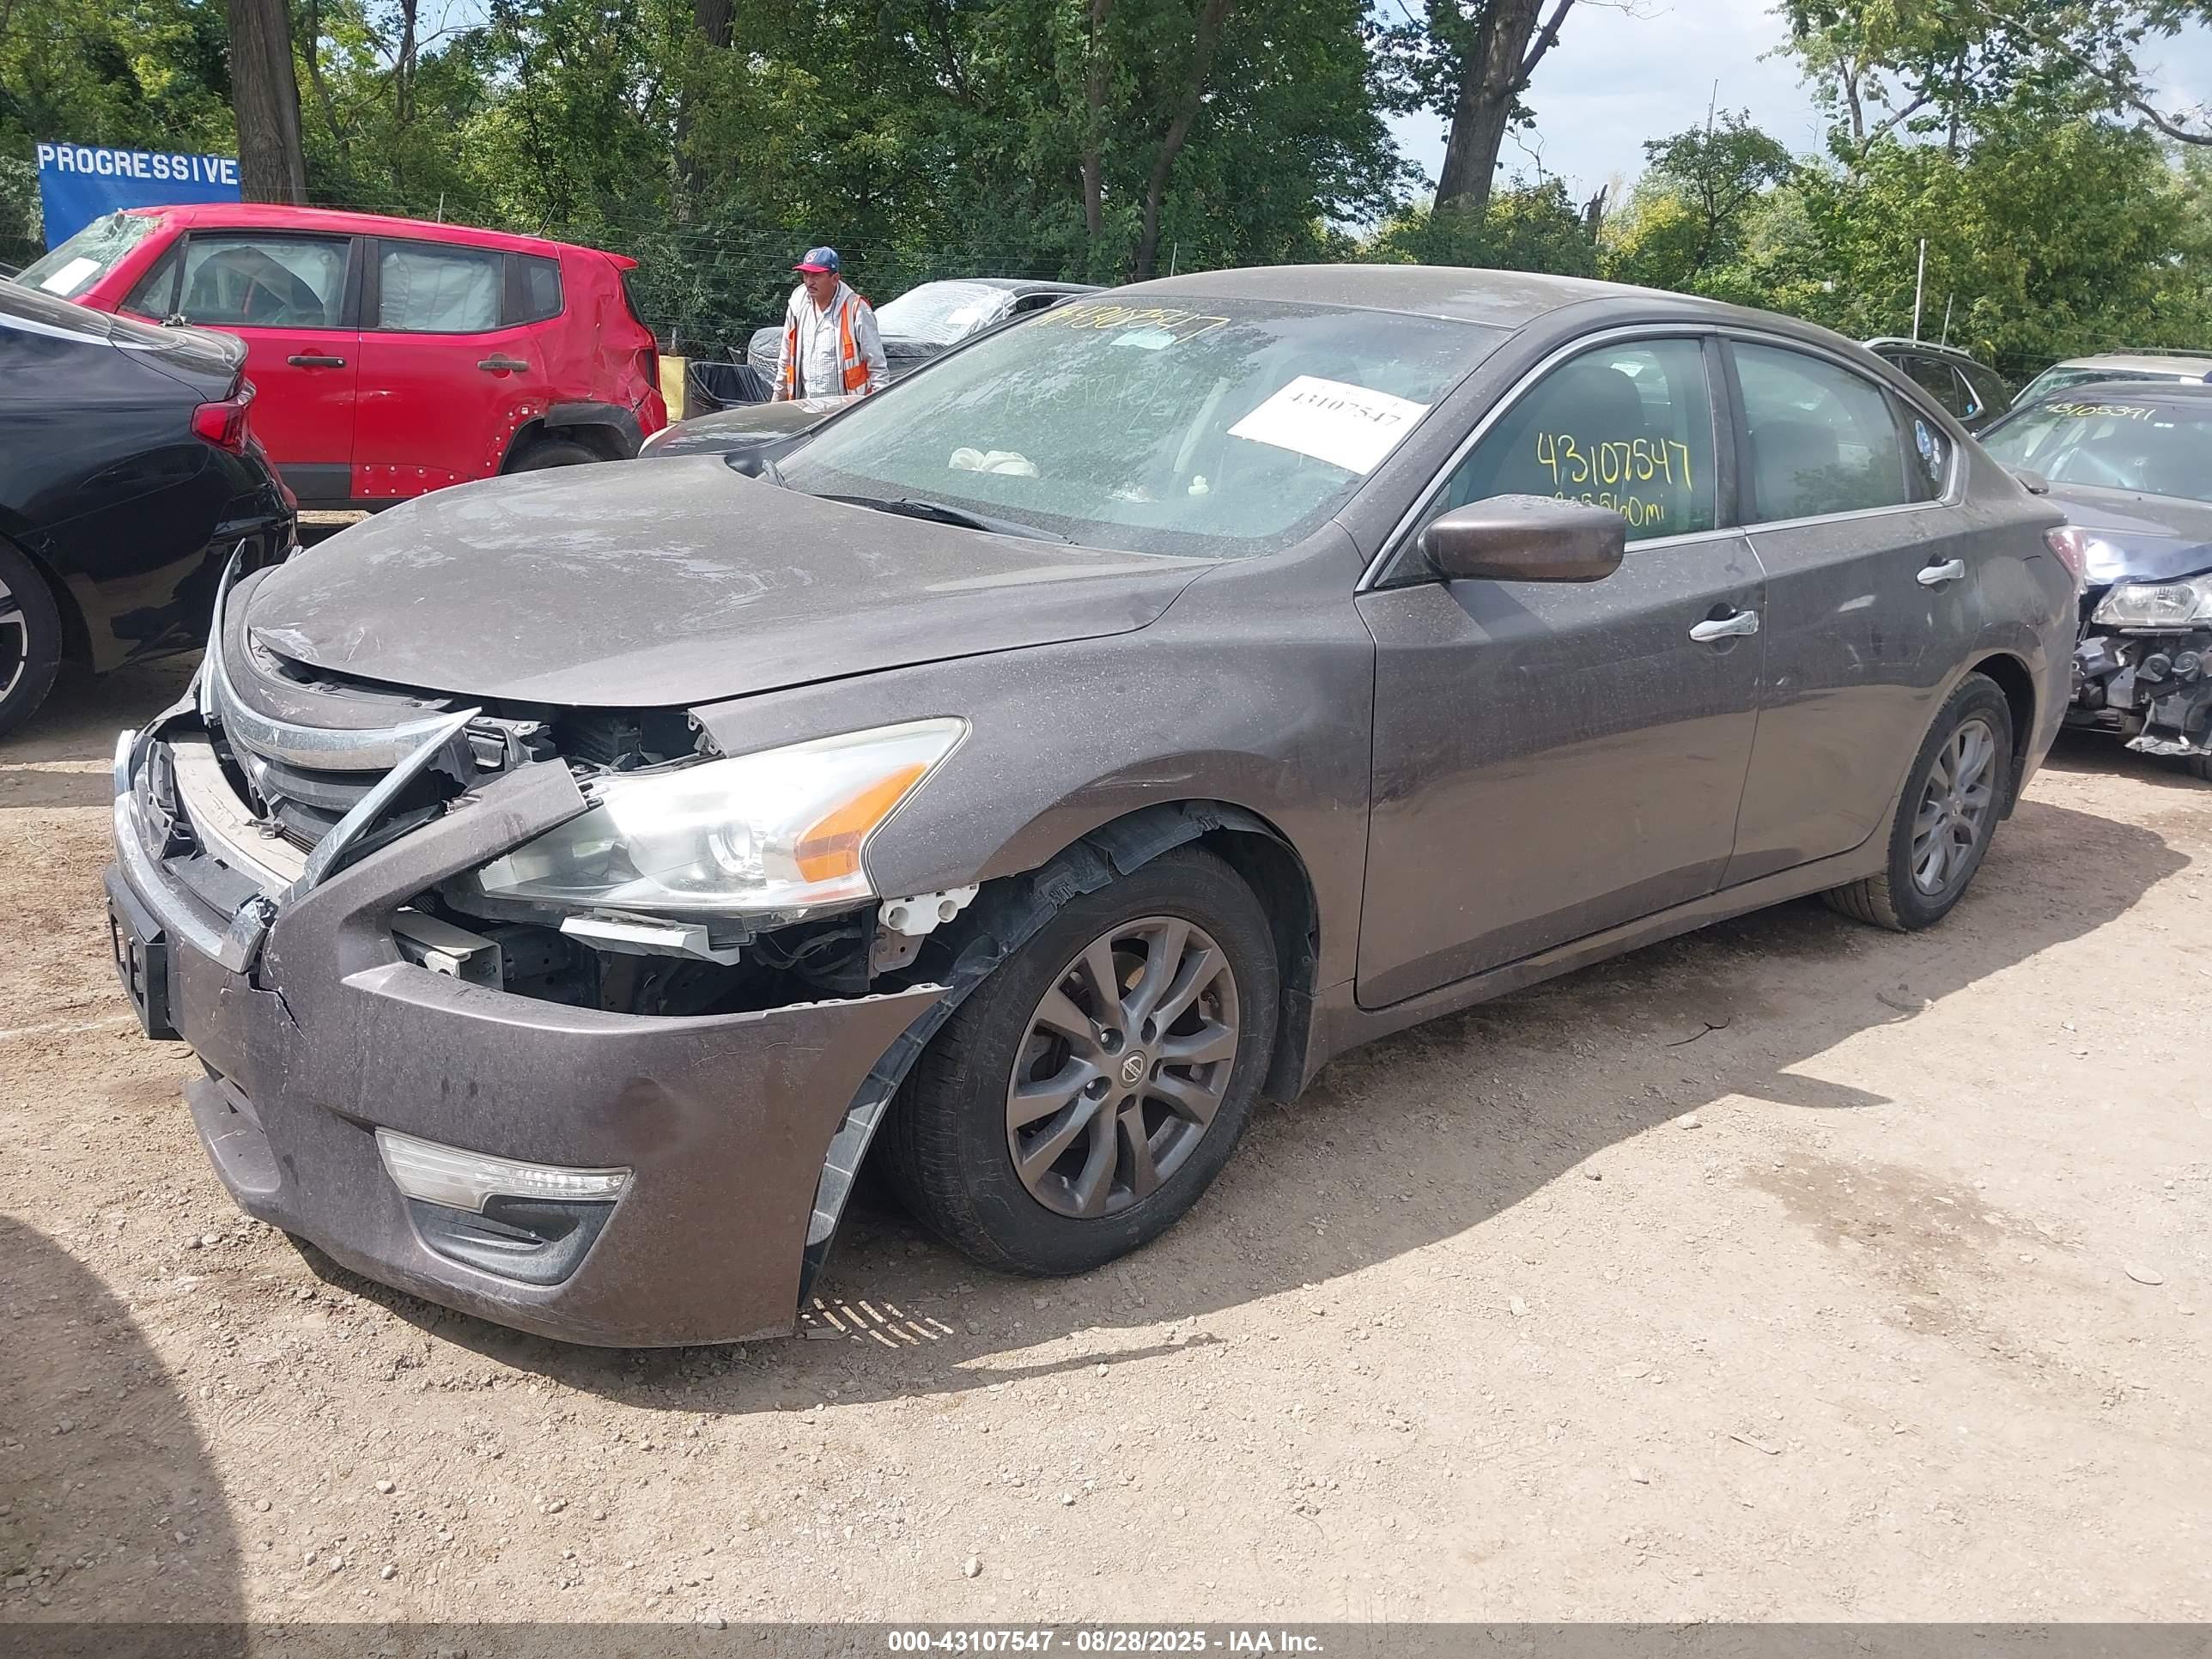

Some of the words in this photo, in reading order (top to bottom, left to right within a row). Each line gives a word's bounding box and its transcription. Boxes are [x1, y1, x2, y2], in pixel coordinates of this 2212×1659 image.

[37, 144, 239, 185] PROGRESSIVE
[2045, 403, 2156, 421] 43105391
[1537, 432, 1693, 493] 43107547
